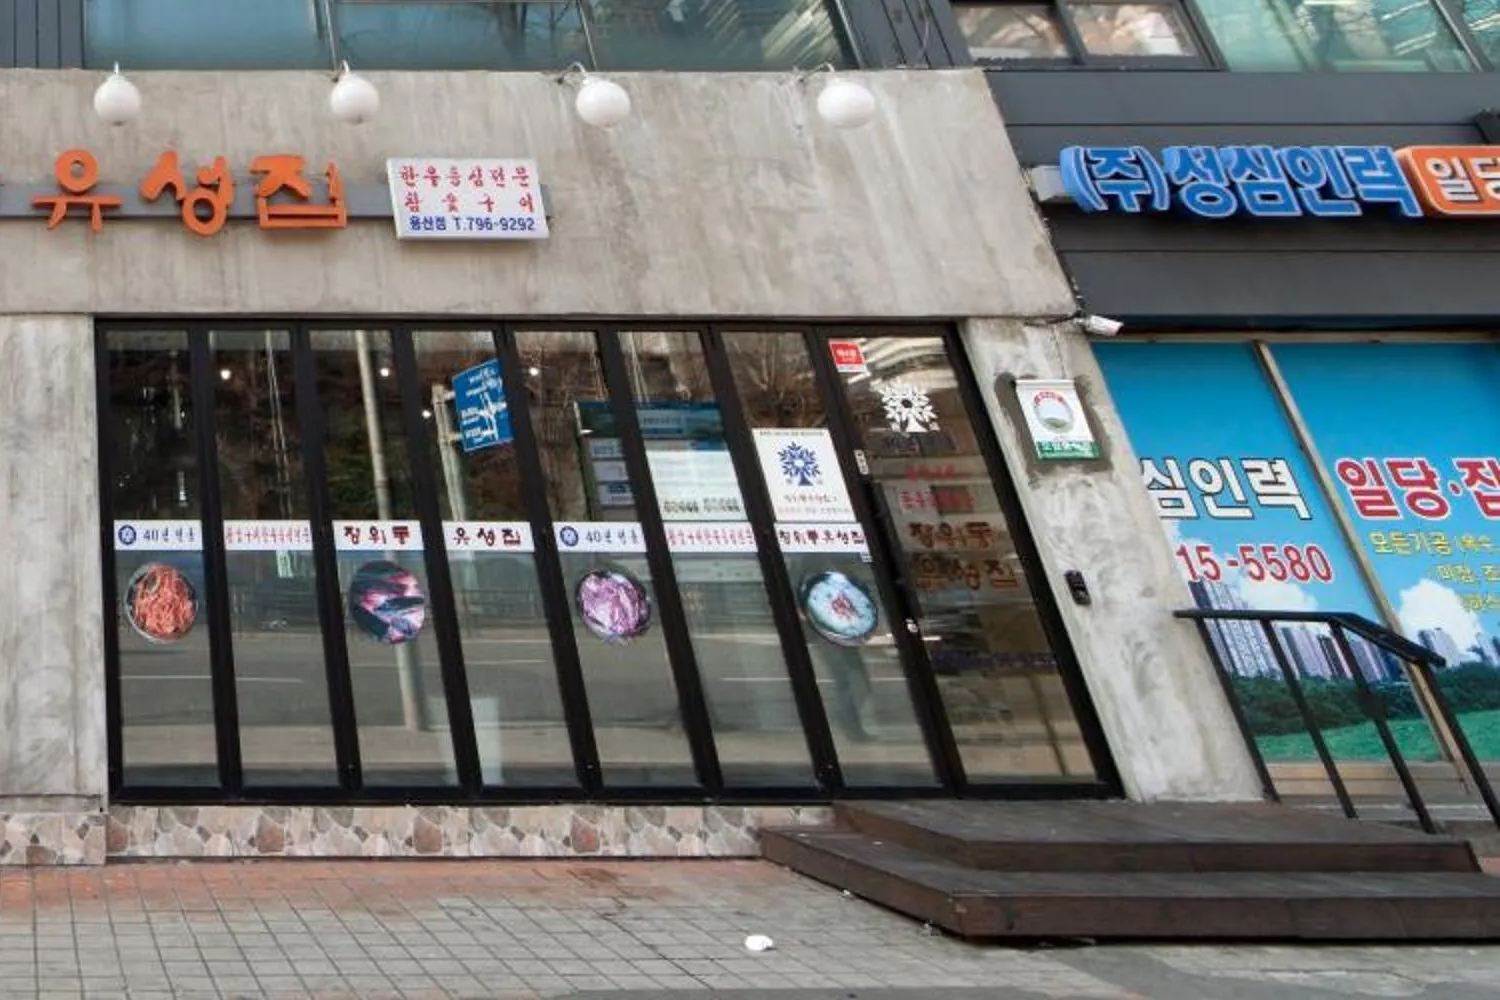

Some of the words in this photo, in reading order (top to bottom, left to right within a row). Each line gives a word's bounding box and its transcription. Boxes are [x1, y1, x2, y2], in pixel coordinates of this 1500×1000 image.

[30, 149, 347, 235] 유성집
[1061, 146, 1423, 217] (주)성심인력
[409, 215, 446, 231] 용산점
[343, 525, 410, 545] 장위동
[452, 526, 521, 547] 유성집
